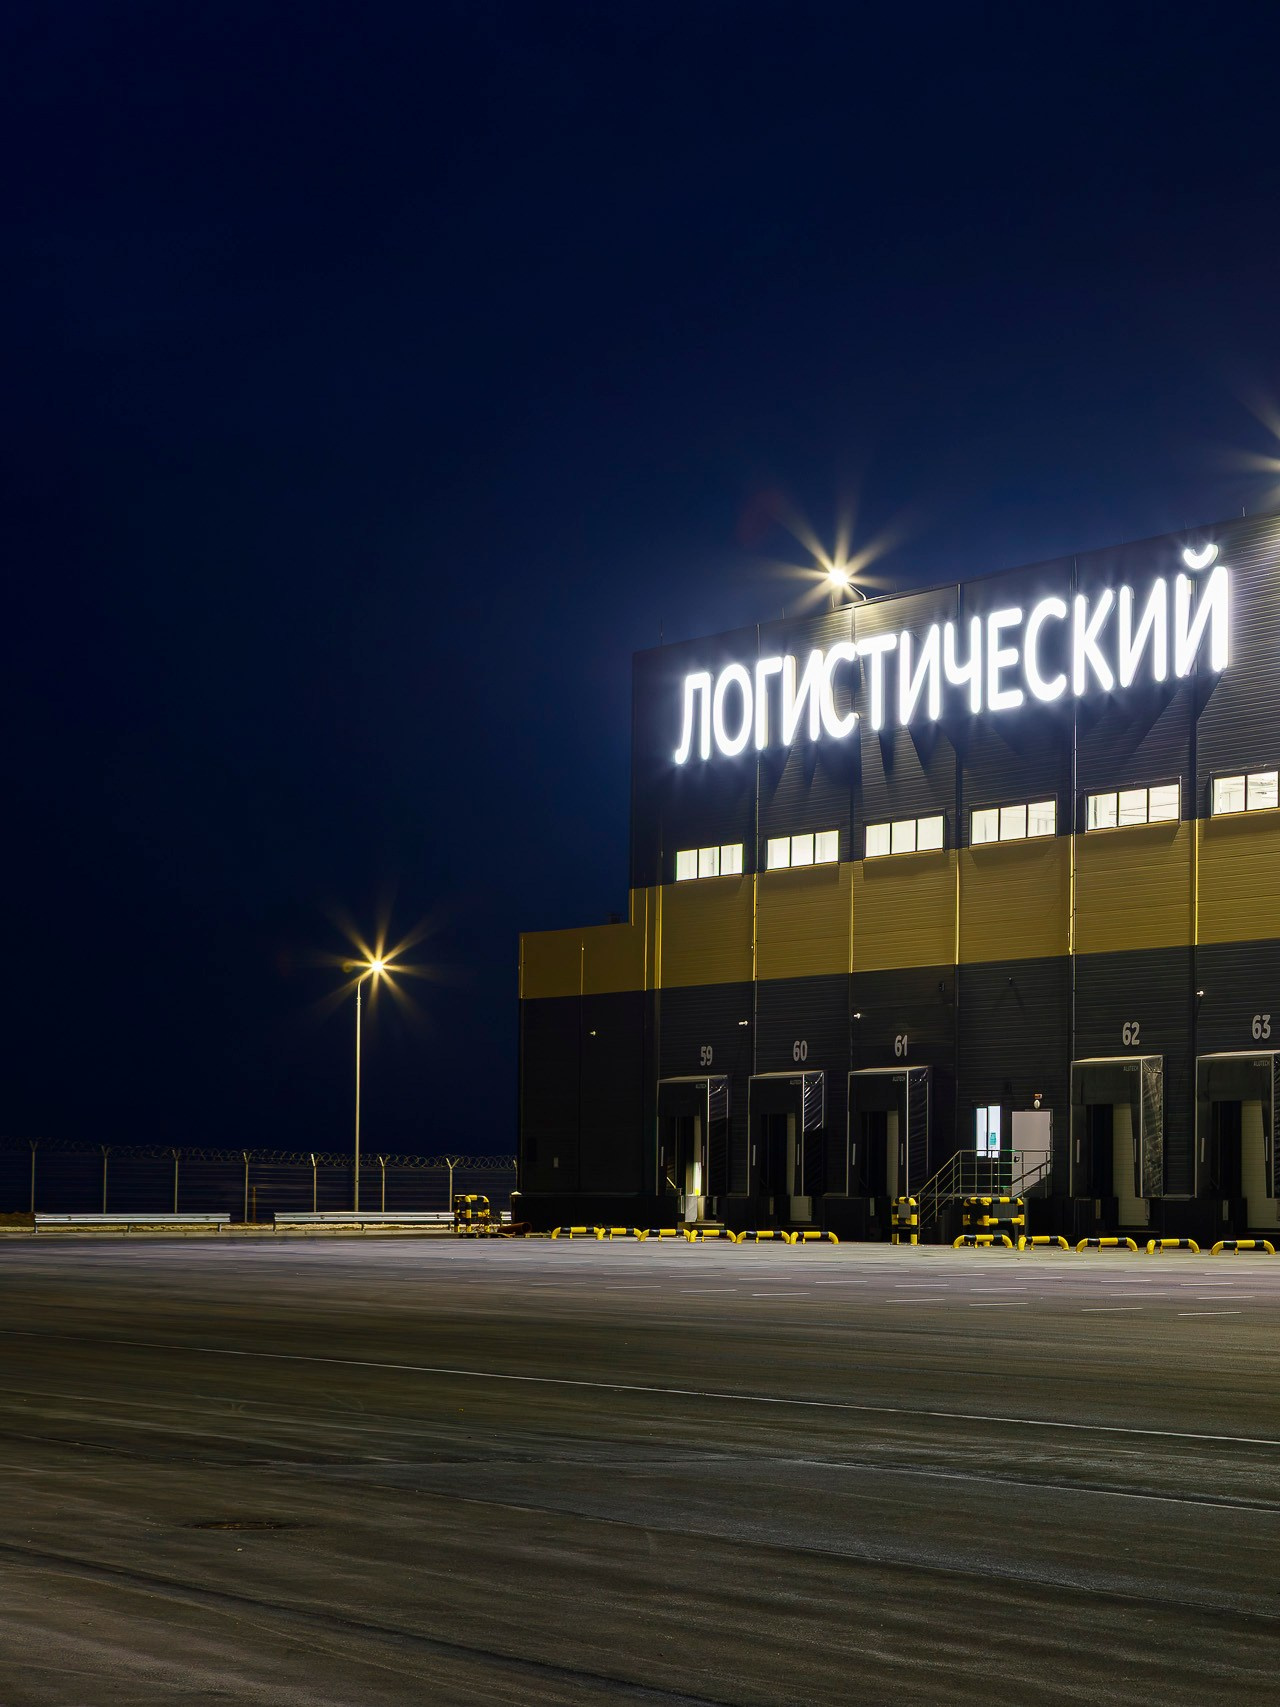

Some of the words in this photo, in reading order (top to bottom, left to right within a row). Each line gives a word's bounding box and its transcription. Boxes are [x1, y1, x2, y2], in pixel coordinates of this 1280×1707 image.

[673, 542, 1232, 766] ЛОГИСТИЧЕСКИЙ
[1122, 1021, 1140, 1046] 62
[1251, 1014, 1271, 1039] 63
[700, 1045, 713, 1067] 59
[793, 1040, 808, 1062] 60
[894, 1034, 908, 1057] 61
